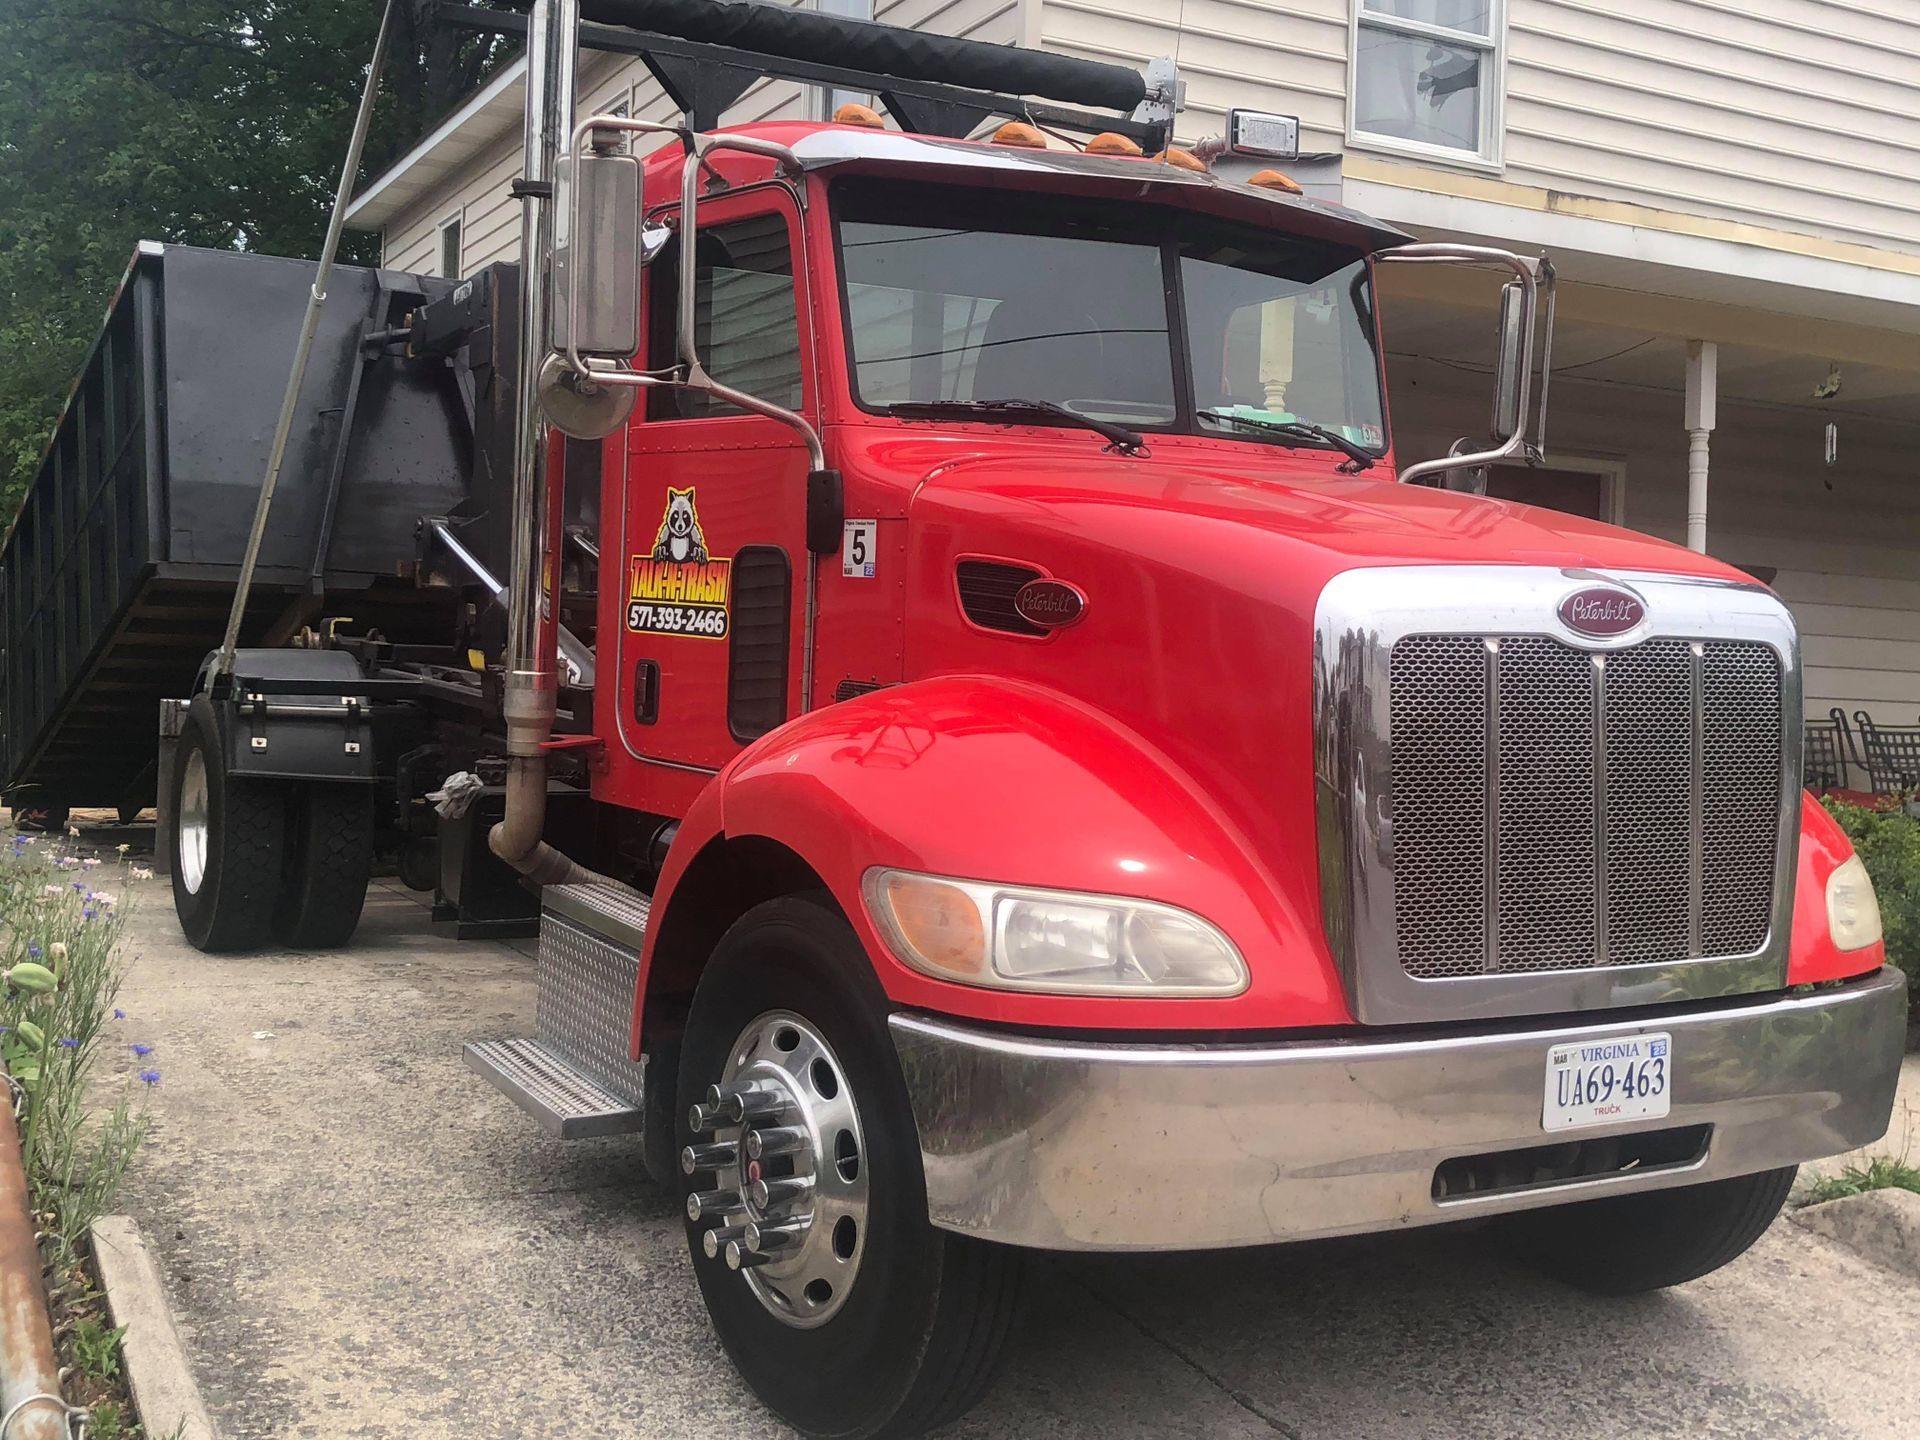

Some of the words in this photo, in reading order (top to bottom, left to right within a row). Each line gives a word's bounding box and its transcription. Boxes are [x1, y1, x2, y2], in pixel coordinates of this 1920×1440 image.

[852, 529, 866, 566] 5
[632, 559, 729, 603] TALK-N-TRASH
[1021, 588, 1076, 613] Peterbilt
[1572, 596, 1637, 622] Peterbilt
[629, 605, 726, 634] 571-393-2466
[1553, 1054, 1568, 1065] MAR
[1581, 1043, 1640, 1062] VIRGINIA
[1653, 1045, 1666, 1056] 22
[1558, 1057, 1665, 1107] UA69-463
[1594, 1105, 1621, 1116] TRUCK
